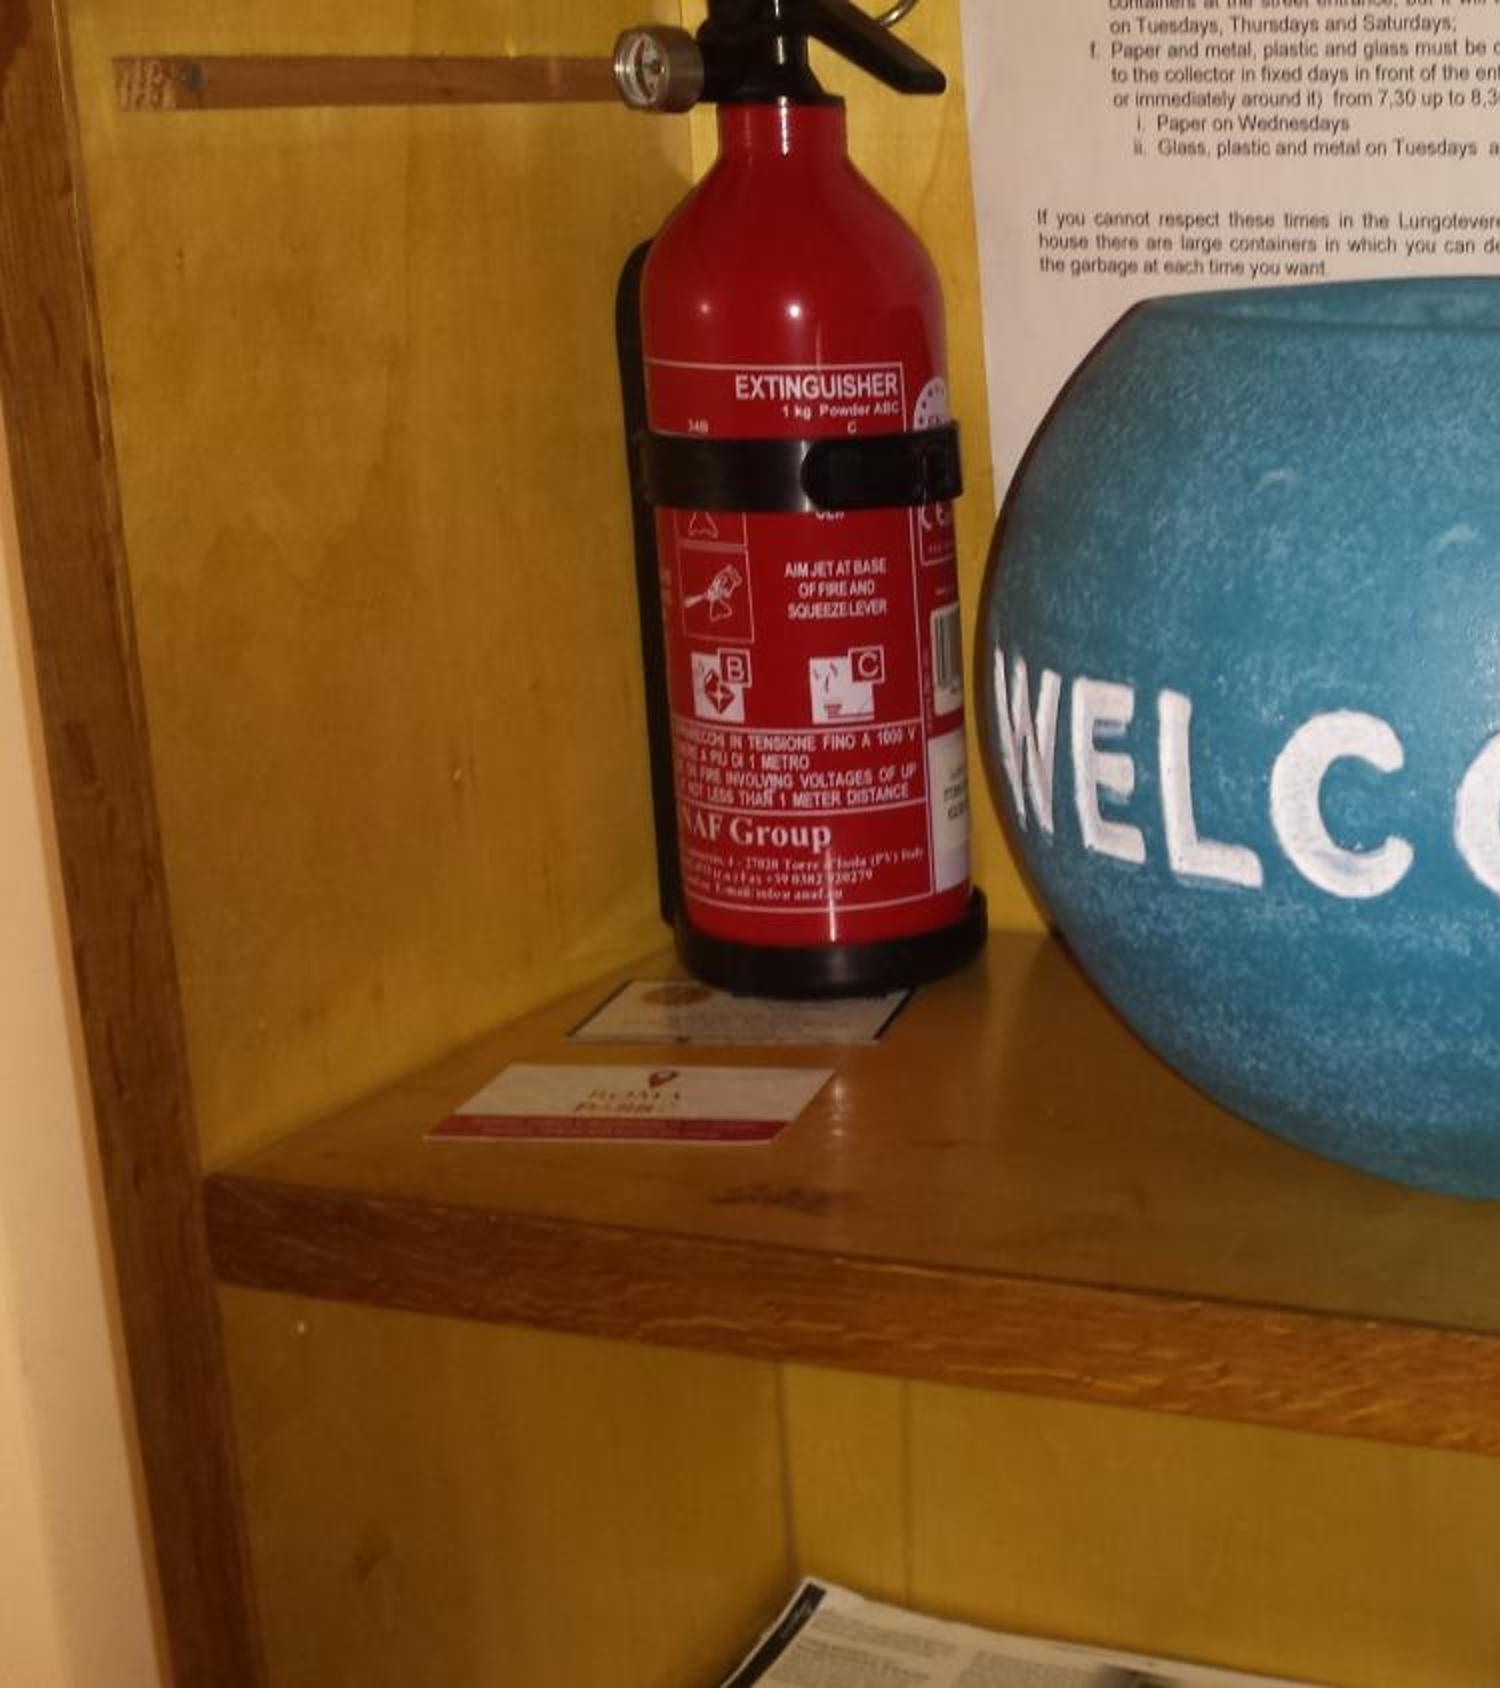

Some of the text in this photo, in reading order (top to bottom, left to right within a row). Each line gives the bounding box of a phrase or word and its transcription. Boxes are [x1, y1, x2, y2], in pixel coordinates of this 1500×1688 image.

[1110, 18, 1131, 33] on
[1135, 15, 1224, 37] Tuesdays,
[1229, 15, 1319, 37] Thursdays
[1325, 16, 1357, 32] and
[1111, 41, 1160, 61] Paper
[1167, 42, 1199, 58] and
[1263, 39, 1319, 61] plastic
[1363, 39, 1409, 60] glass
[1415, 39, 1459, 56] must
[1465, 38, 1487, 55] be
[1112, 67, 1127, 83] to
[1133, 66, 1159, 82] the
[1165, 66, 1235, 82] collector
[1261, 65, 1301, 81] fixed
[1308, 64, 1349, 86] days
[1375, 63, 1414, 80] front
[1113, 93, 1129, 107] or
[1135, 90, 1235, 110] immediately
[1241, 90, 1301, 107] around
[1333, 88, 1373, 106] from
[1421, 92, 1443, 109] up
[1157, 113, 1350, 135] Paper on Wednesdays
[1217, 138, 1271, 157] plastic
[1275, 138, 1308, 156] and
[1314, 138, 1360, 155] metal
[1393, 137, 1477, 158] Tuesdays
[1037, 209, 1048, 225] If
[1056, 212, 1086, 229] you
[1093, 210, 1151, 227] cannot
[1158, 211, 1220, 230] respect
[1228, 211, 1276, 228] these
[1283, 212, 1330, 229] times
[1339, 211, 1353, 229] in
[1362, 212, 1390, 230] the
[1039, 232, 1089, 249] house
[1095, 233, 1139, 250] there
[1146, 236, 1173, 251] are
[1180, 234, 1223, 254] large
[1229, 235, 1317, 252] containers
[1347, 236, 1397, 253] which
[1405, 239, 1437, 257] you
[1443, 239, 1475, 253] can
[1040, 257, 1065, 273] the
[1071, 257, 1138, 277] garbage
[1143, 260, 1158, 274] at
[1163, 258, 1205, 274] each
[1209, 259, 1244, 274] time
[1250, 261, 1281, 279] you
[735, 373, 899, 400] EXTINGUISHER
[782, 401, 900, 420] 1 kg Powder ABC
[785, 558, 887, 578] AIM JET AT BASE
[799, 579, 875, 598] OF FIRE AND
[787, 599, 887, 619] SQUEEZE LEVER
[726, 651, 880, 679] B C
[730, 735, 743, 751] IN
[748, 735, 816, 752] TENSIONE
[823, 732, 855, 749] FINO
[861, 731, 870, 747] A
[906, 727, 916, 741] V
[761, 754, 810, 771] METRO
[725, 770, 793, 790] INVOLVING
[800, 771, 873, 788] VOLTAGES
[879, 768, 894, 781] OF
[792, 788, 842, 807] METER
[848, 782, 910, 804] DISTANCE
[730, 815, 832, 854] Group
